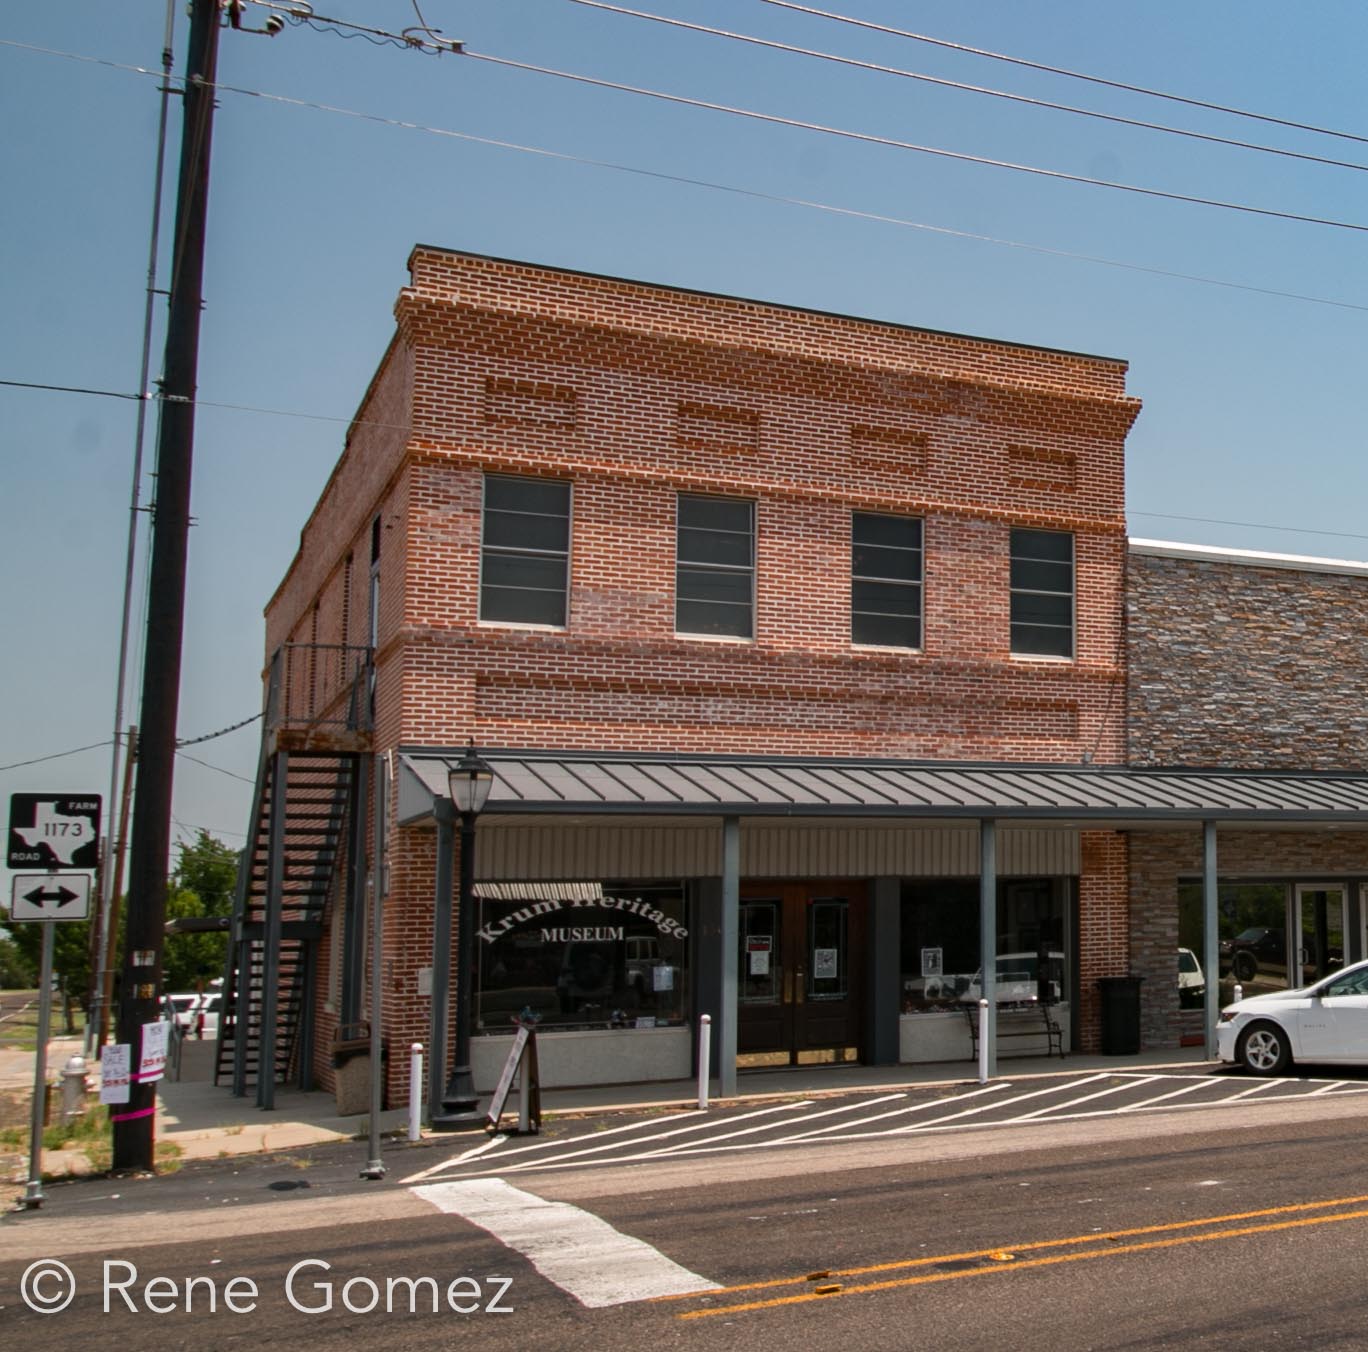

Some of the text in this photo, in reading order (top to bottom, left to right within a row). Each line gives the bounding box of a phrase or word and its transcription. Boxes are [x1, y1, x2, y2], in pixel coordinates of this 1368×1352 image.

[68, 801, 98, 810] FARM
[44, 822, 82, 837] 1173
[11, 852, 41, 861] ROAD
[475, 898, 563, 944] Krum
[540, 926, 625, 943] MUSEUM
